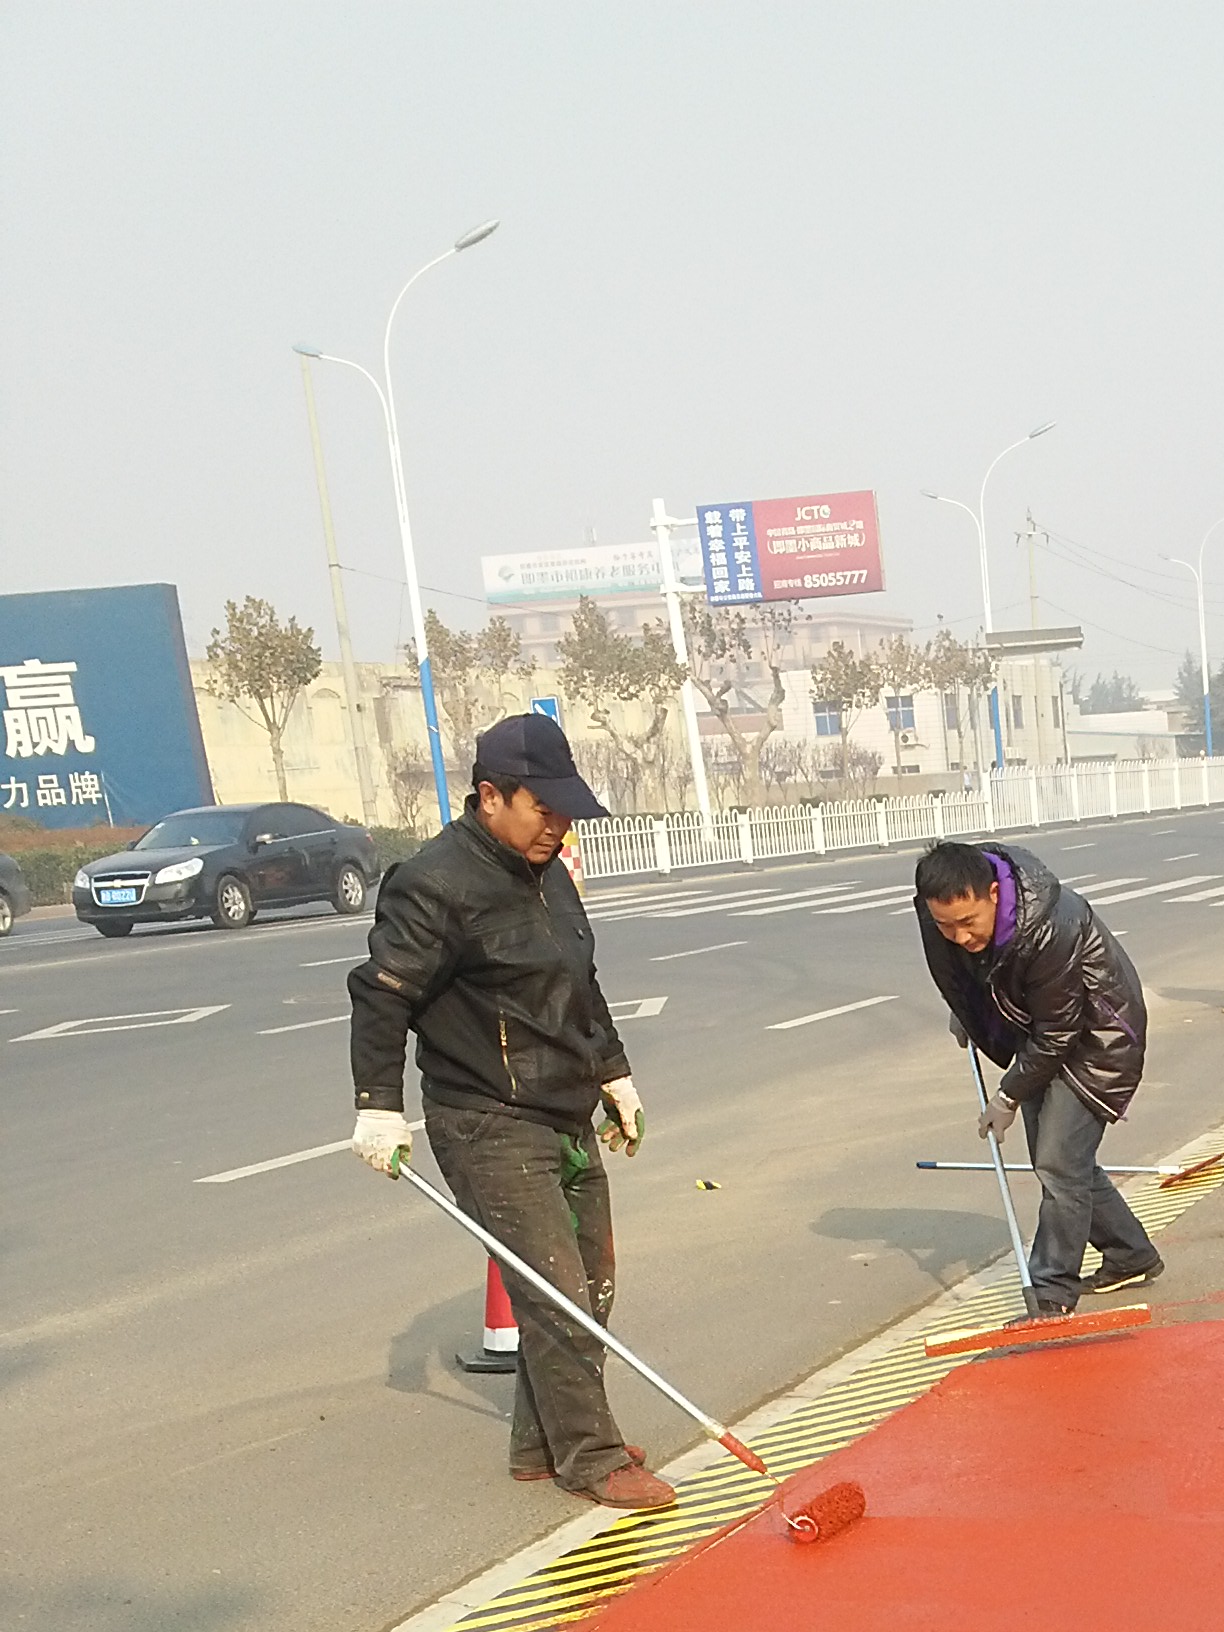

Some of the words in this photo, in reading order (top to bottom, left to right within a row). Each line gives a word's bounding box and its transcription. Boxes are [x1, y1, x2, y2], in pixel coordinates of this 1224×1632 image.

[729, 508, 755, 591] 带上平安上路
[803, 569, 868, 588] 85055777
[0, 658, 95, 758] 赢
[1, 771, 103, 809] 力品牌
